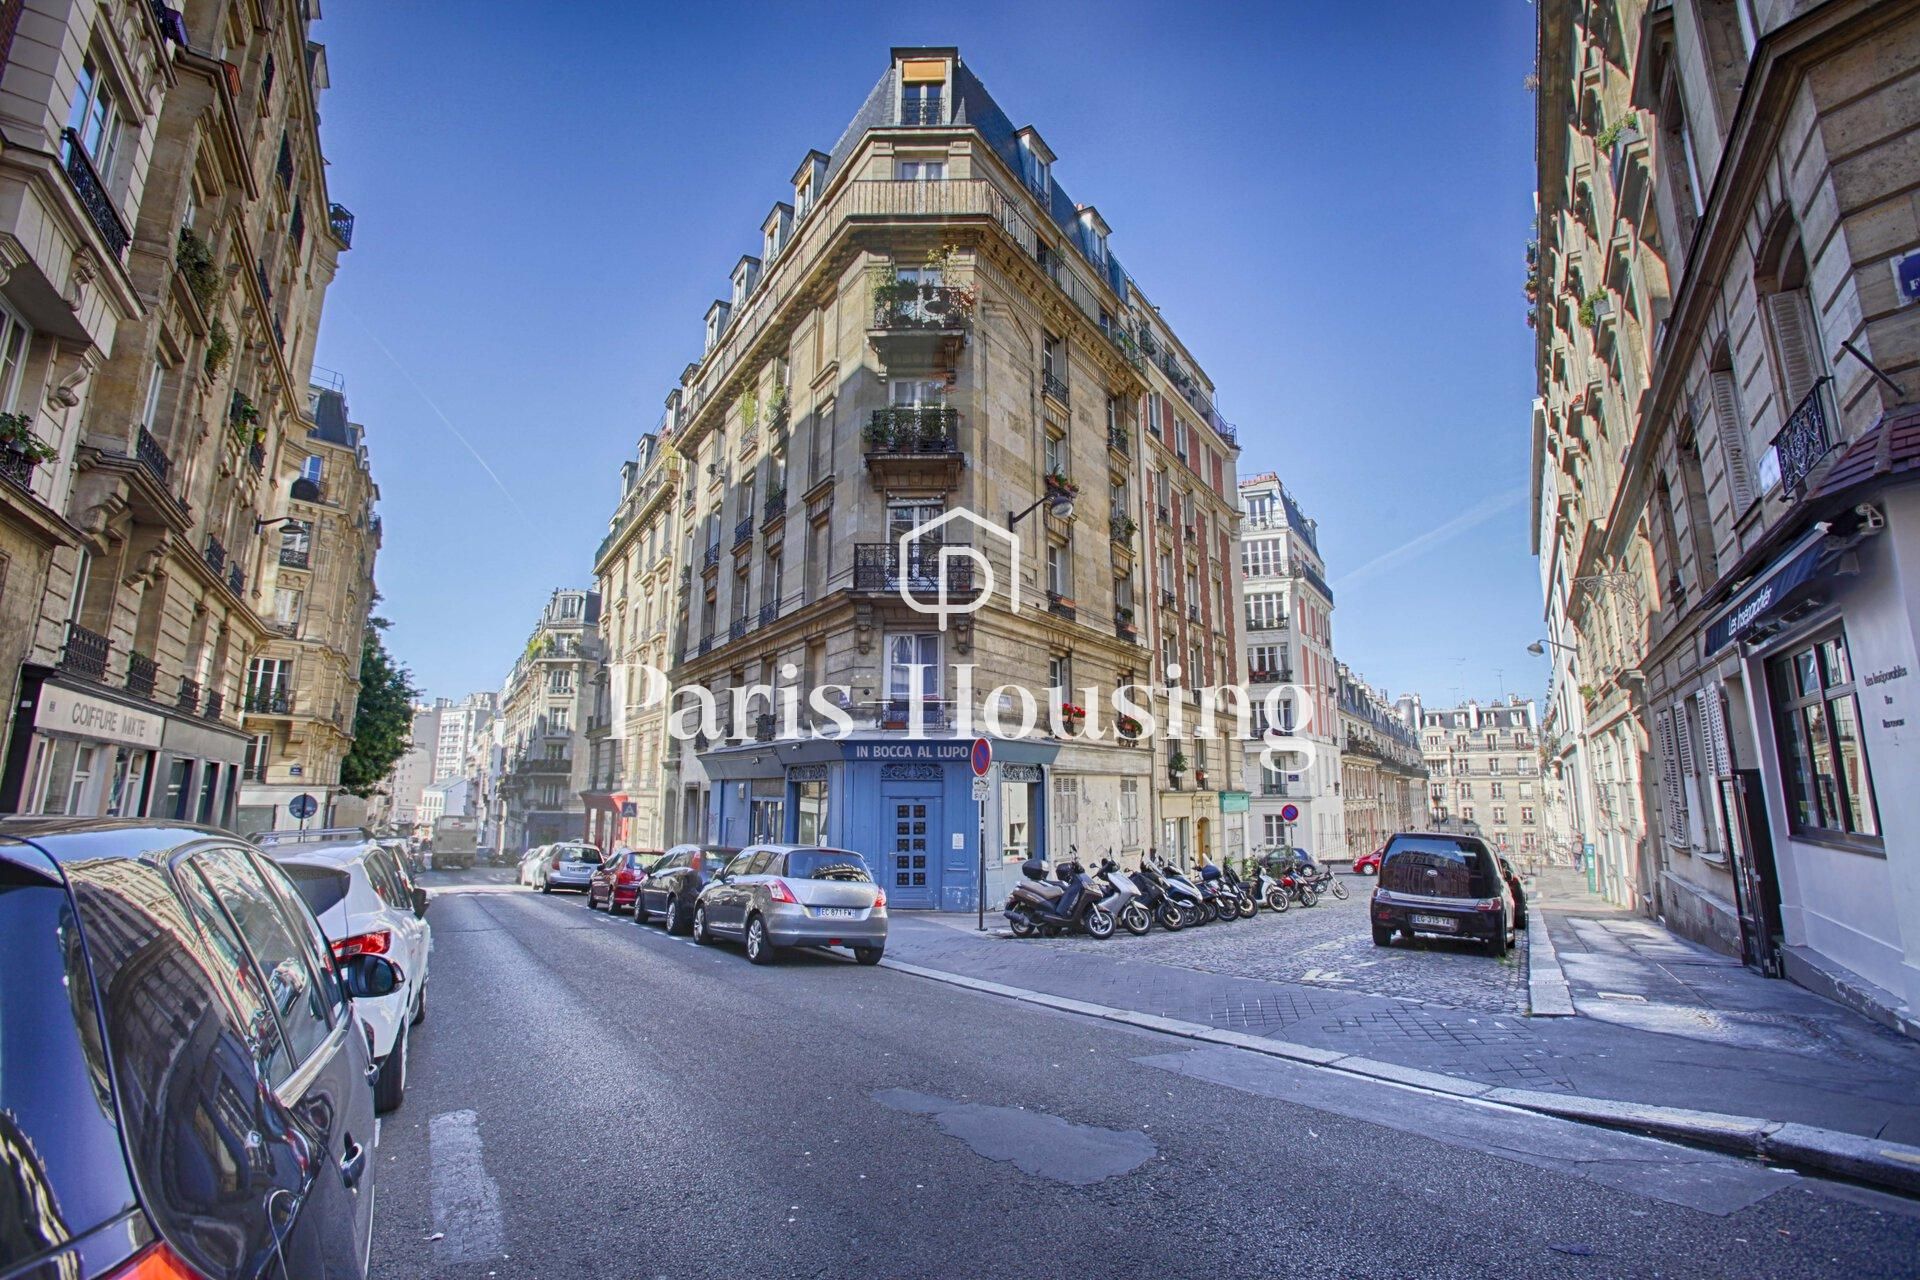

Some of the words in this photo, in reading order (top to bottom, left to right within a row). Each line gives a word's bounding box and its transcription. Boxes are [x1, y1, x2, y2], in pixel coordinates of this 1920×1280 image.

[72, 702, 118, 732] COIFFURE
[121, 715, 146, 738] MIXTE
[856, 745, 868, 758] IN
[873, 745, 913, 758] BOCCA
[917, 745, 933, 758] AL
[937, 745, 969, 758] LUPO
